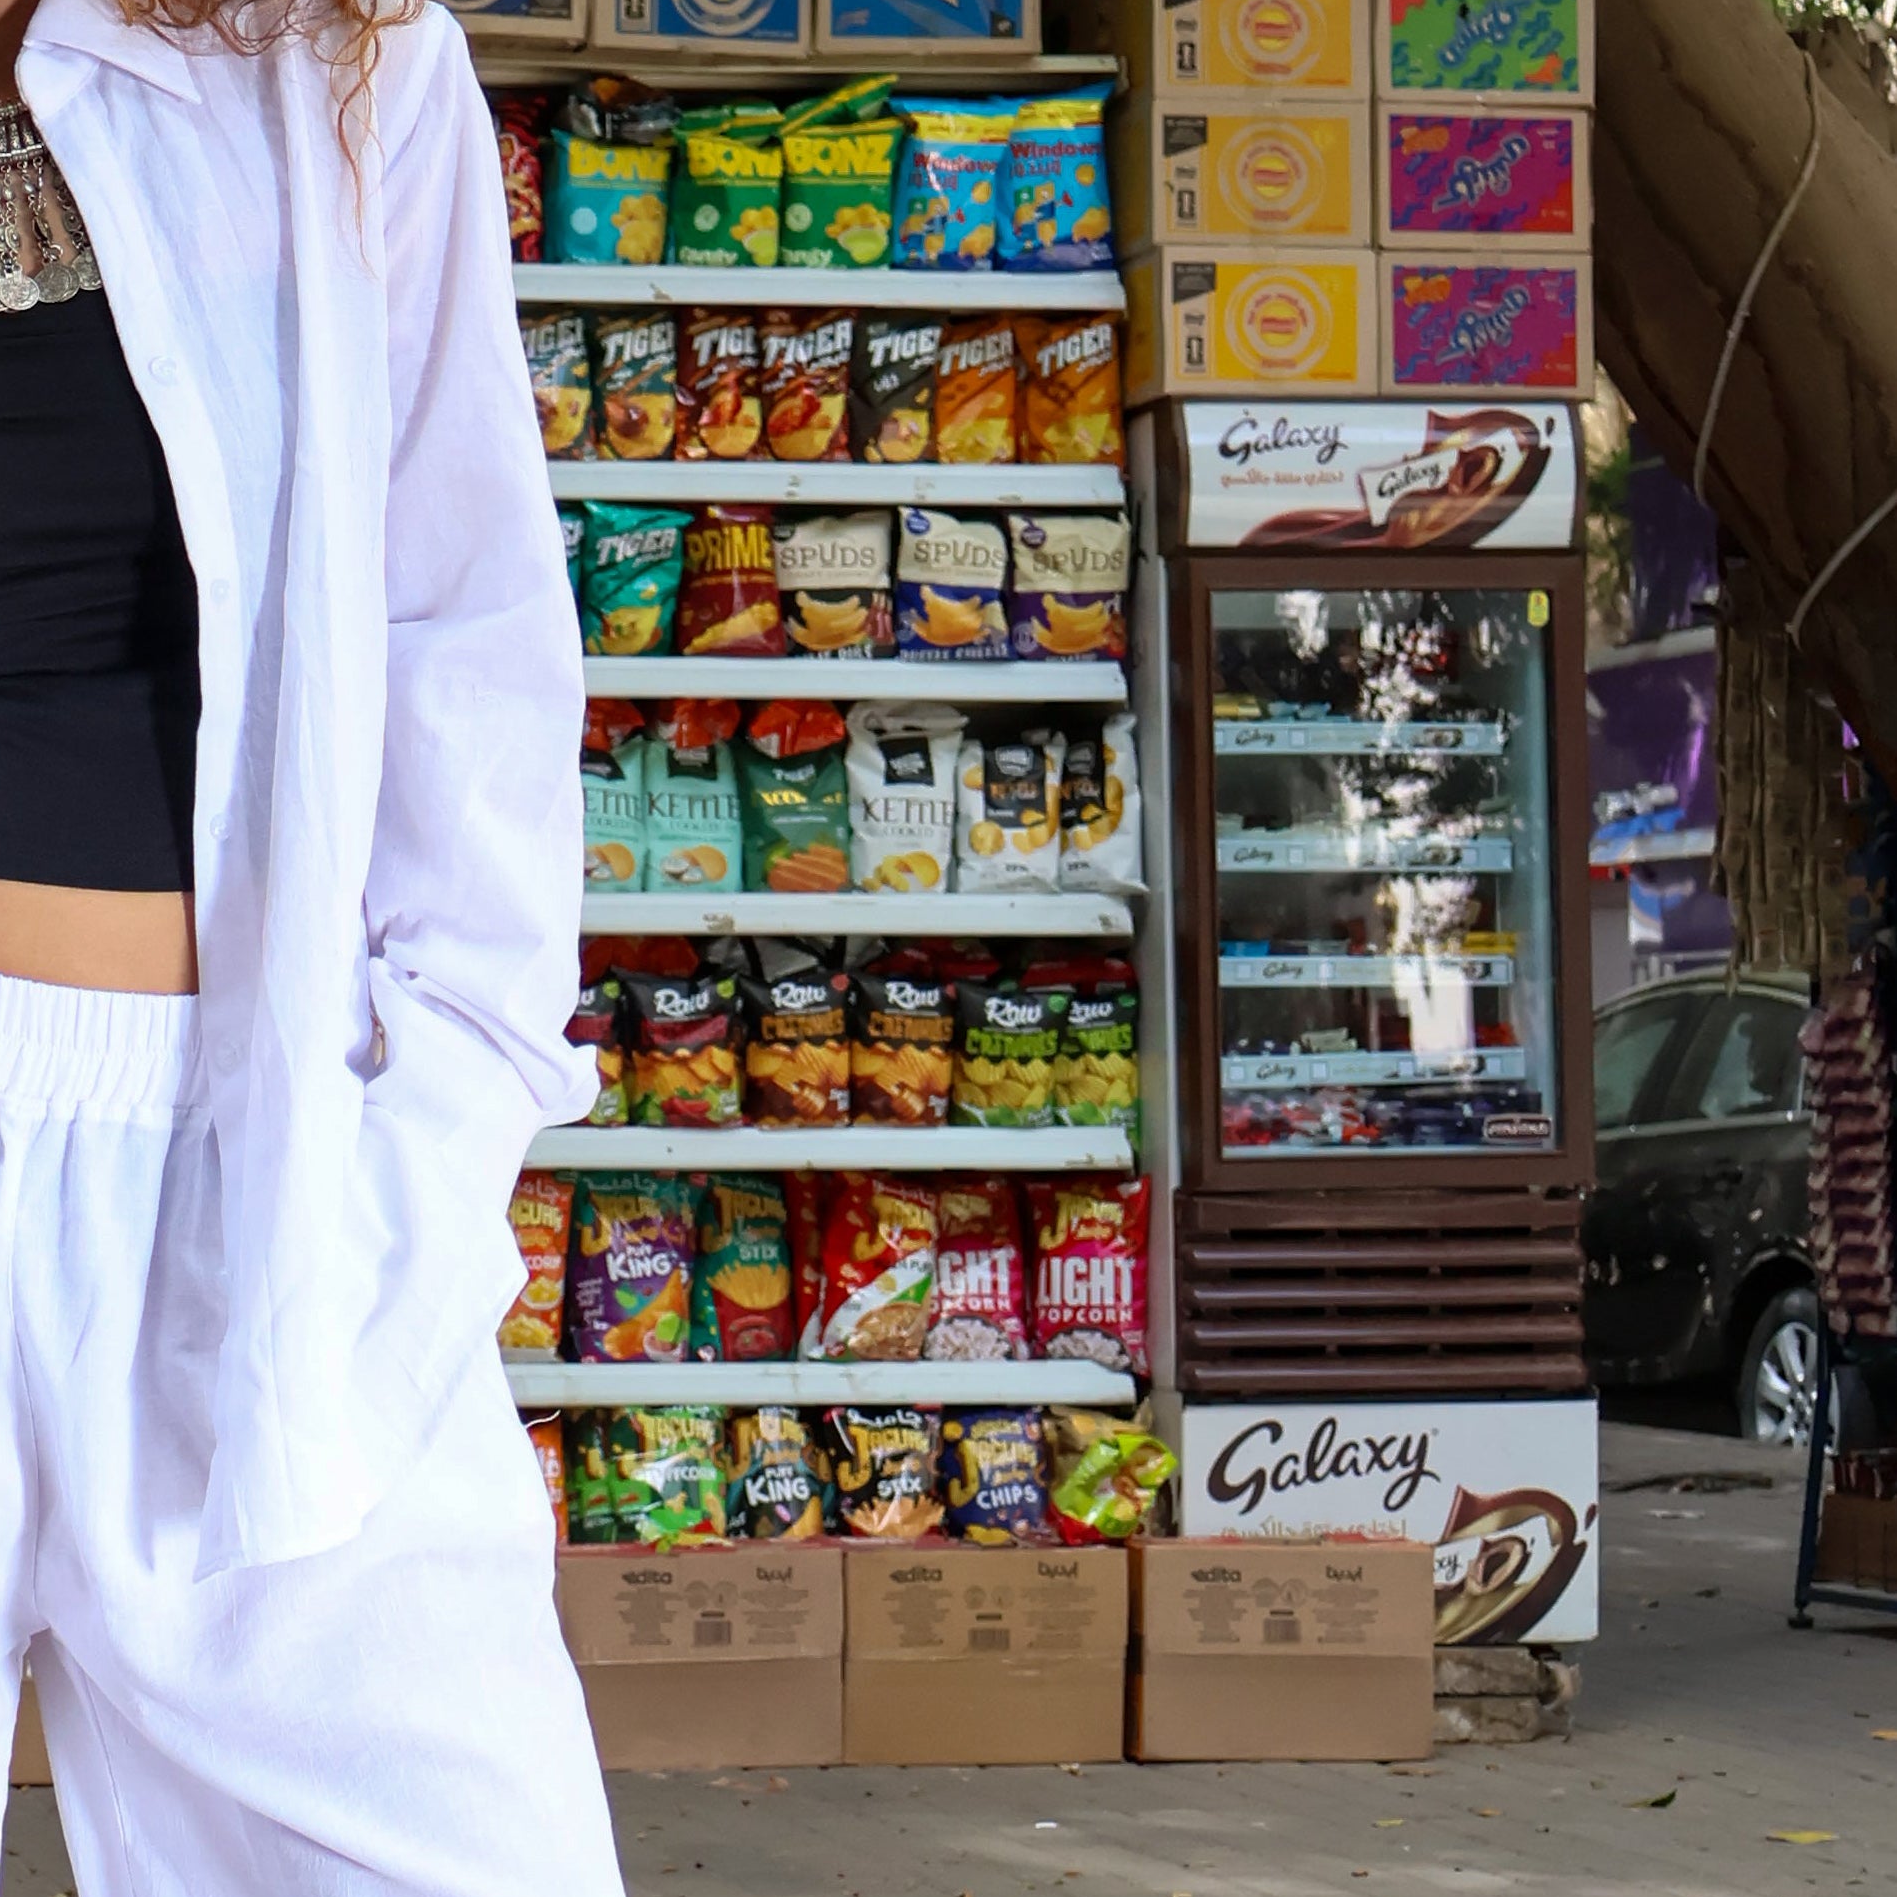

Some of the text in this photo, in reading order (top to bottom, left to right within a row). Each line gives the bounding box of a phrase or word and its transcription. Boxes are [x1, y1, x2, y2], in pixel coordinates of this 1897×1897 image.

[784, 134, 893, 177] BONZ
[762, 318, 852, 369] TIGER
[941, 330, 1014, 377] TIGER
[1036, 323, 1112, 378] TIGER
[1218, 415, 1349, 464] Galaxy
[1377, 458, 1442, 500] Galaxy
[687, 524, 773, 571] PRIME
[780, 540, 876, 569] SPUDS
[914, 539, 1003, 569] SPUDS
[1033, 545, 1123, 573] SPUDS
[772, 981, 827, 1009] Raw
[884, 981, 941, 1009] Raw
[985, 996, 1043, 1028] Raw
[605, 1250, 673, 1283] KING
[738, 1243, 780, 1261] STIX
[1035, 1255, 1136, 1309] LIGHT
[1037, 1307, 1133, 1325] POPCORN
[1207, 1416, 1441, 1515] Galaxy
[744, 1476, 810, 1506] KING
[976, 1484, 1038, 1510] CHIPS
